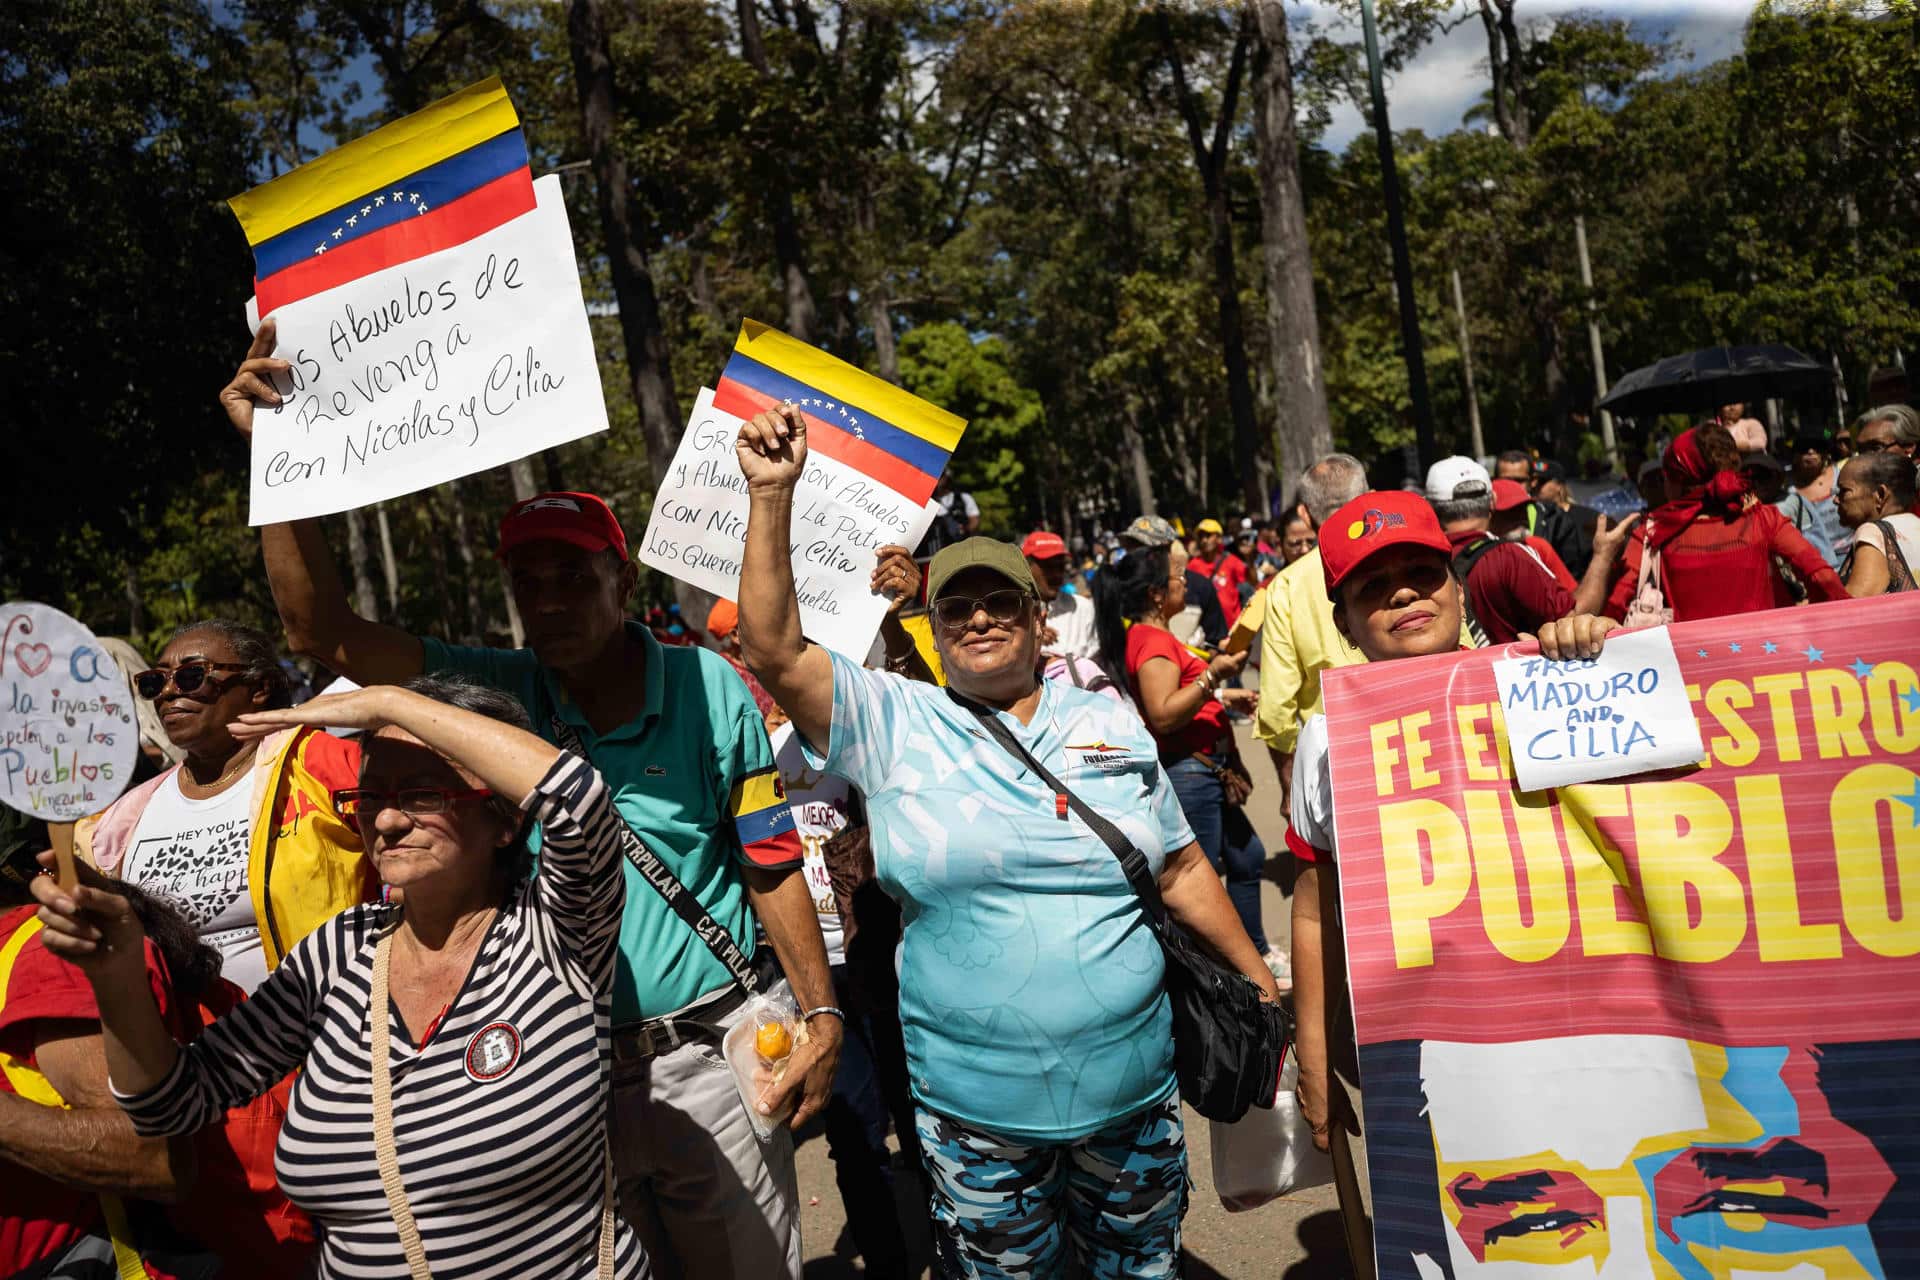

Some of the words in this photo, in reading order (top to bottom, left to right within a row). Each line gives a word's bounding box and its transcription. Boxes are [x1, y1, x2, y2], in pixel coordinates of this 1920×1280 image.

[329, 276, 457, 362] Abuelos
[475, 254, 524, 299] de
[265, 451, 325, 487] Con
[459, 396, 480, 446] y
[484, 346, 565, 416] Cilia
[693, 419, 738, 454] GR
[835, 481, 910, 534] Abuelos
[694, 459, 750, 495] Abuel
[800, 502, 828, 527] La
[831, 515, 890, 550] Patr
[805, 540, 857, 573] Cilia
[8, 681, 40, 714] la
[1508, 667, 1659, 711] MADURO
[0, 721, 51, 754] peten
[57, 731, 70, 744] a
[1370, 711, 1441, 796] FE
[1688, 661, 1920, 770] STRO
[1566, 705, 1613, 726] AND
[0, 746, 114, 796] Pueblos
[175, 828, 203, 842] HEY
[207, 820, 235, 836] YOU
[802, 804, 838, 827] MEJOR
[196, 866, 248, 891] happ
[1378, 763, 1920, 969] PUEBLO
